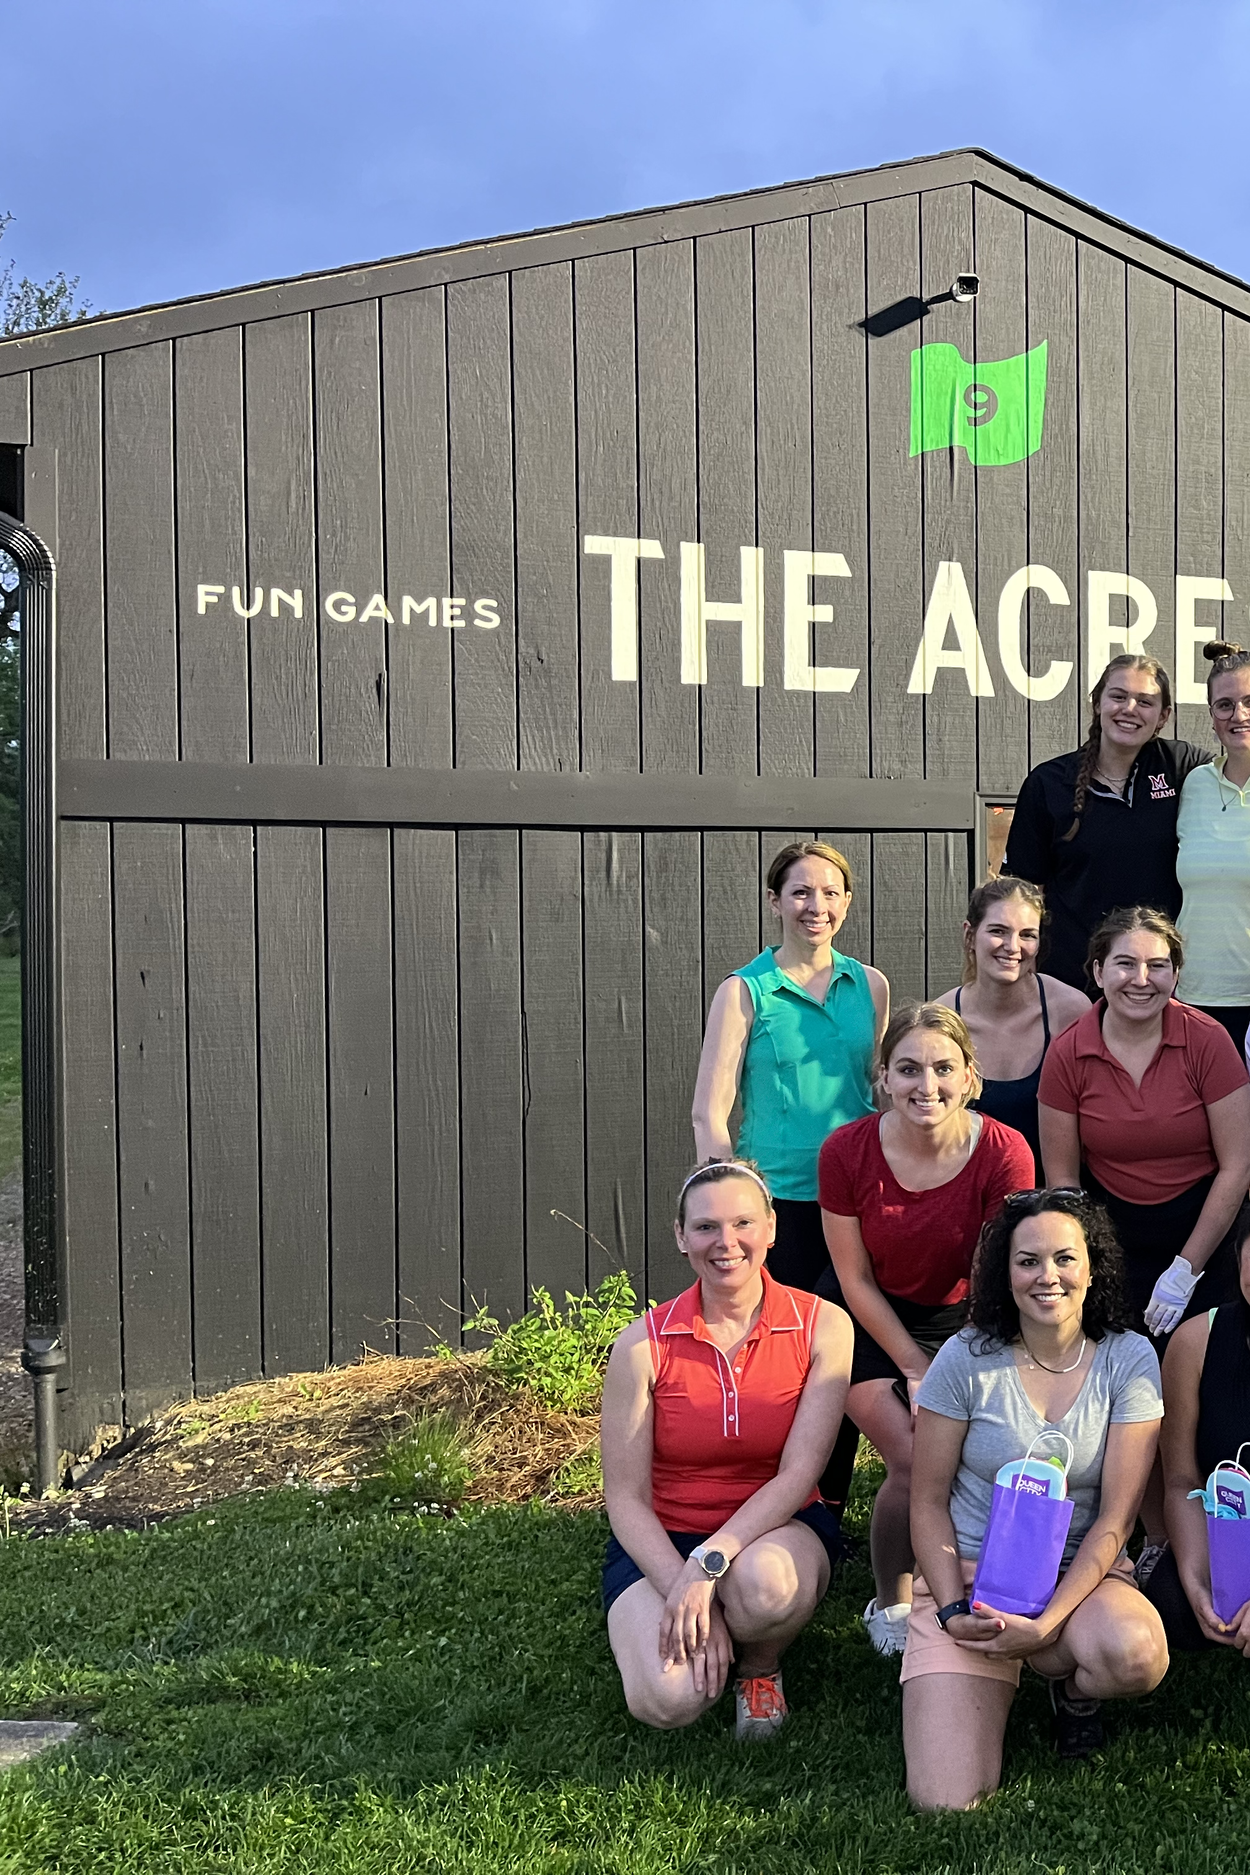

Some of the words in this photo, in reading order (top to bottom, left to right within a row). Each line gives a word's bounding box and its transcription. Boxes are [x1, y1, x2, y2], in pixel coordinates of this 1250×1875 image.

[963, 383, 999, 427] 9
[197, 584, 304, 620] FUN
[324, 591, 501, 630] GAMES
[584, 535, 861, 694] THE
[1147, 773, 1169, 791] M
[1150, 788, 1176, 800] MIAMI
